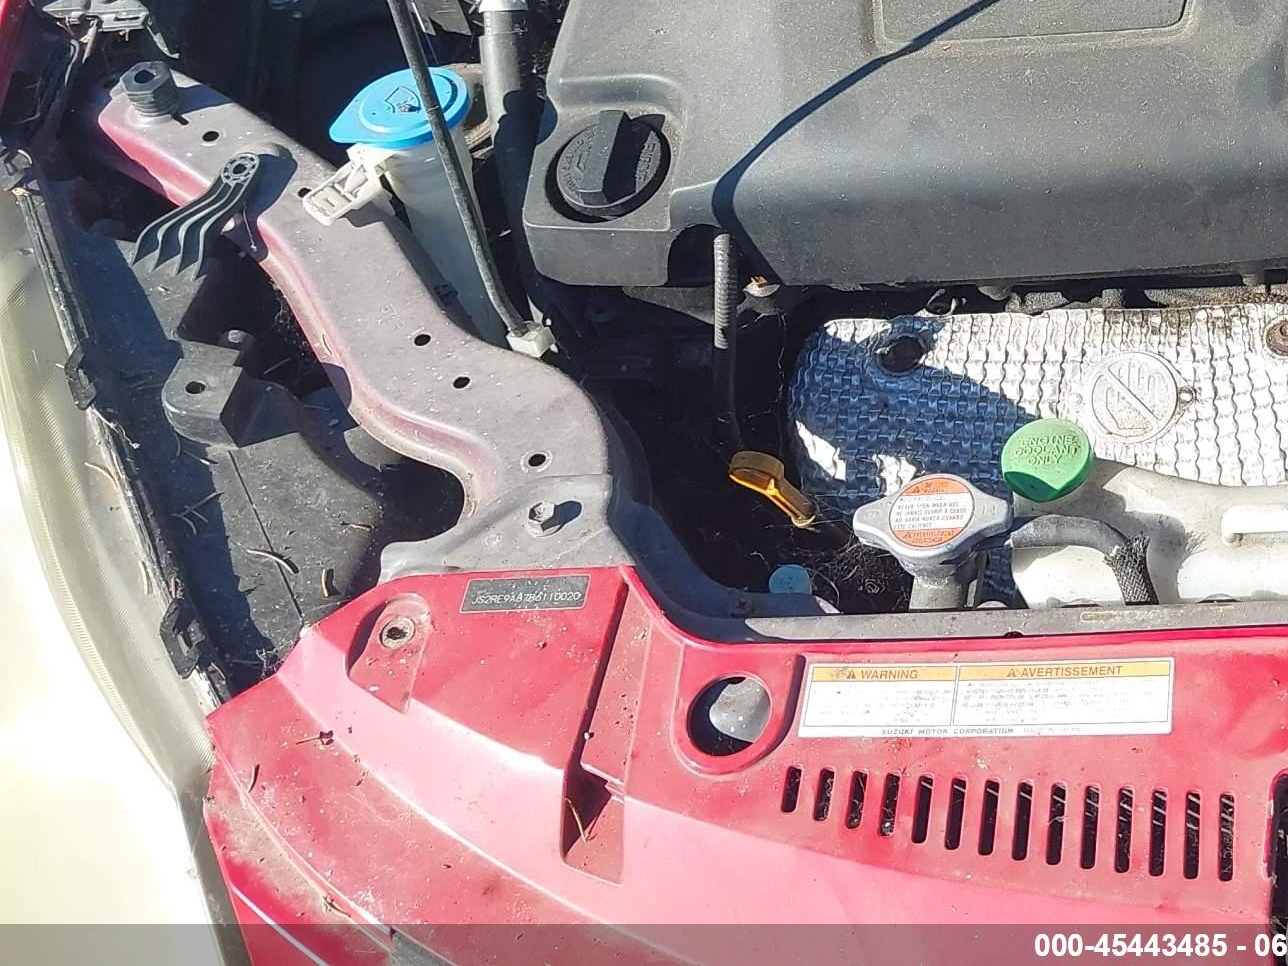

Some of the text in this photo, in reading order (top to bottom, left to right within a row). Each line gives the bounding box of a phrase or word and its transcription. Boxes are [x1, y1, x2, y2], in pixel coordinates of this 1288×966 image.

[1026, 454, 1063, 466] ONLY
[860, 669, 919, 680] WARNING
[1020, 665, 1124, 678] AVERTISSEMENT
[882, 728, 914, 736] SUZUKI
[953, 727, 1014, 735] CORPORATION
